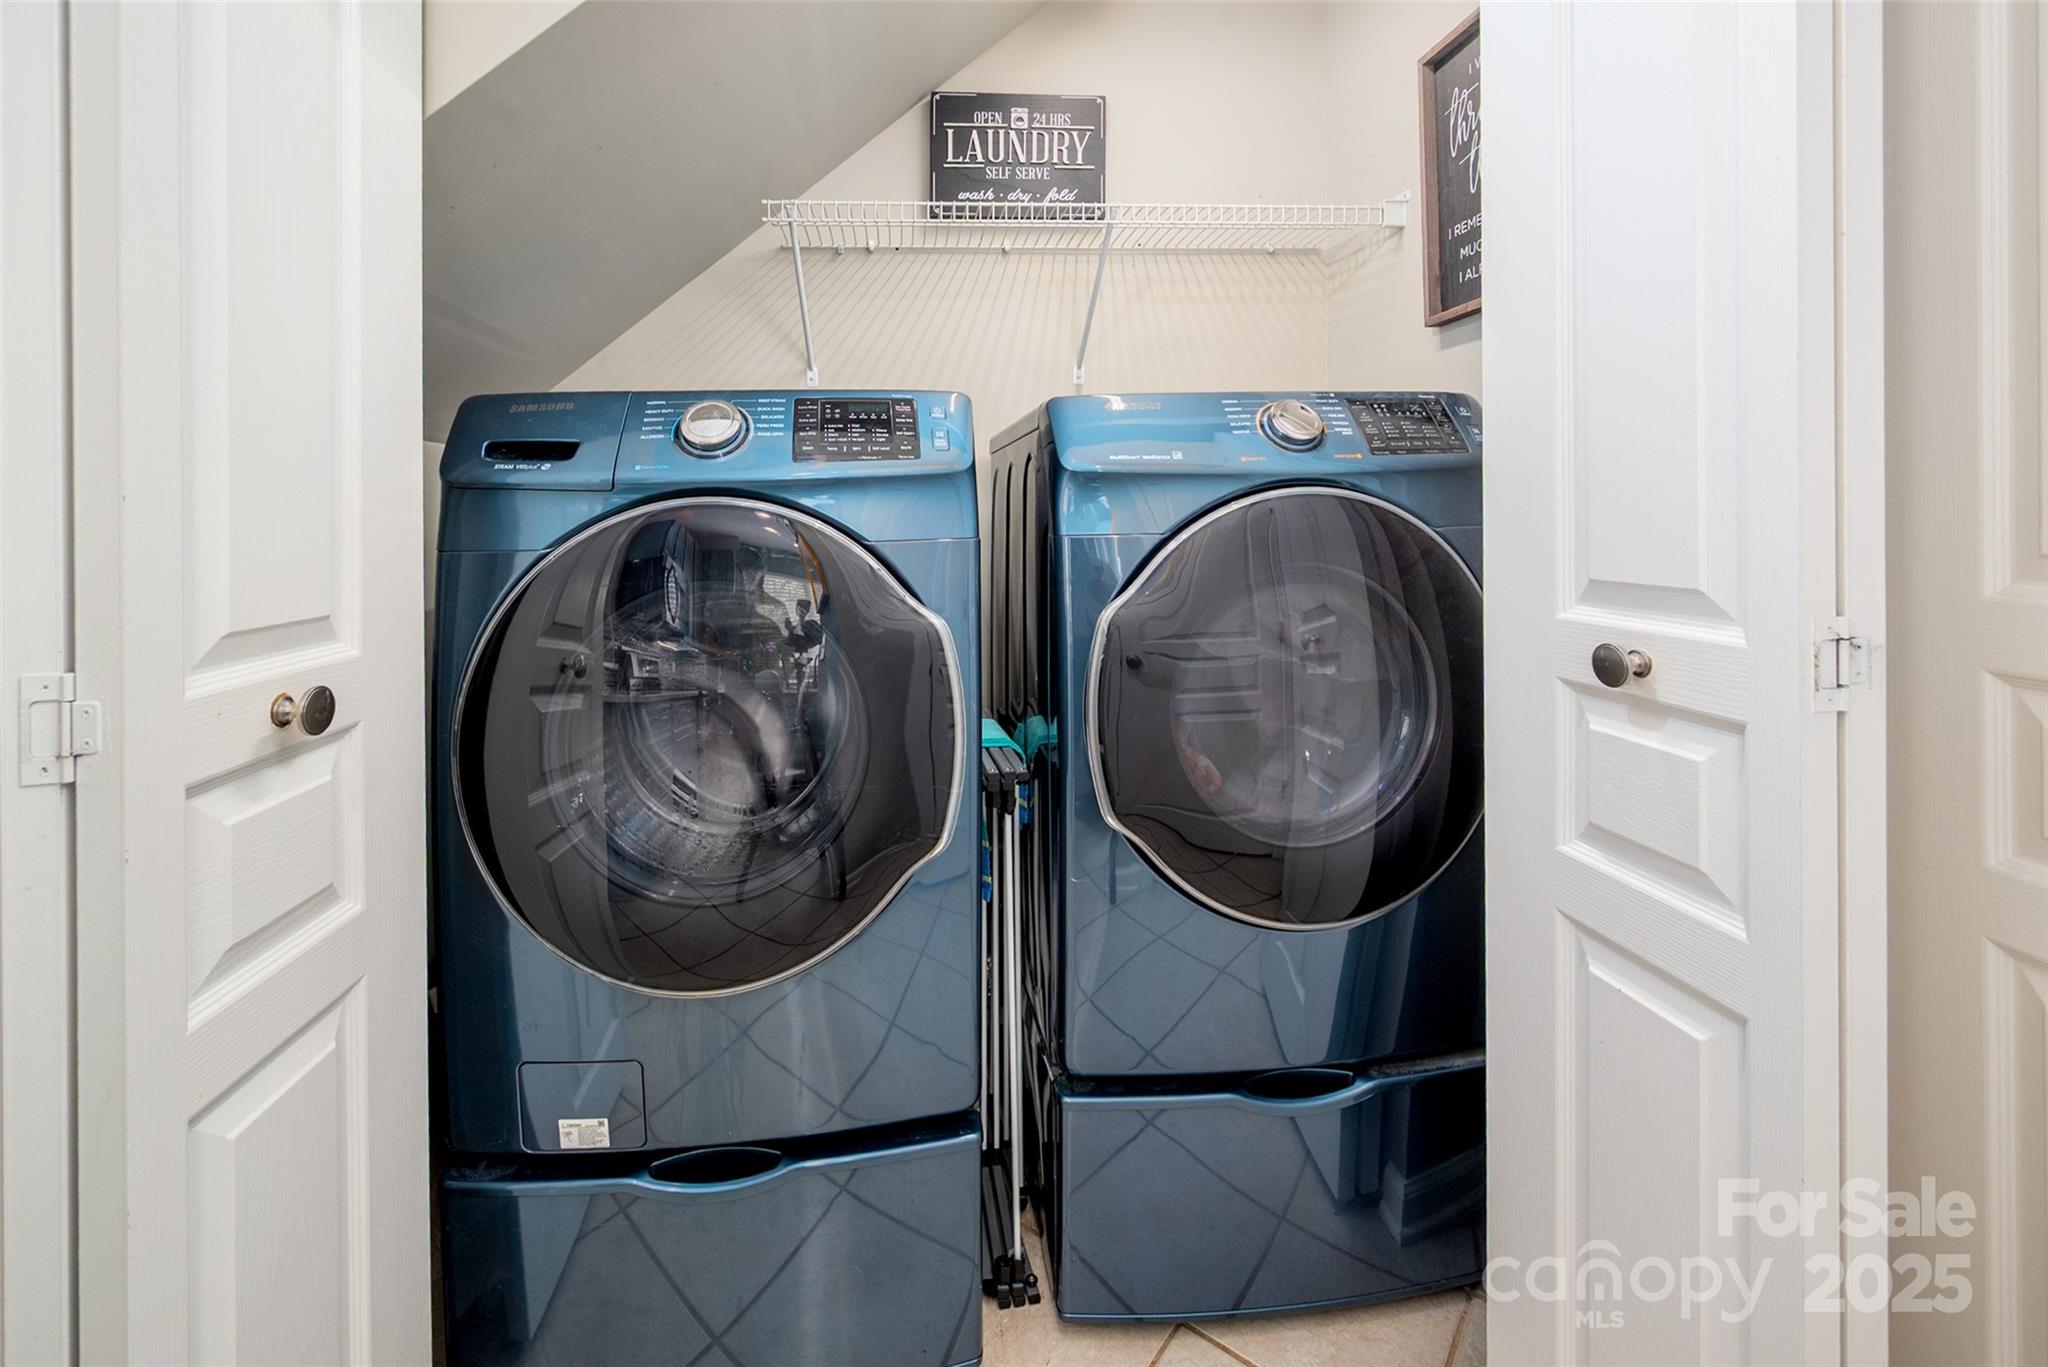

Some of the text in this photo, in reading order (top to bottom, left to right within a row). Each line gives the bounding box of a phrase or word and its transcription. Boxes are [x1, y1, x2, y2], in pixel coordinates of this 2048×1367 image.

[973, 111, 1071, 126] OPEN 24 HRS
[1444, 82, 1480, 157] thr
[945, 128, 1092, 165] LAUNDRY
[985, 166, 1050, 180] SELF SERVE
[957, 187, 1079, 204] wash dry fold
[508, 401, 577, 414] SAMSUNG
